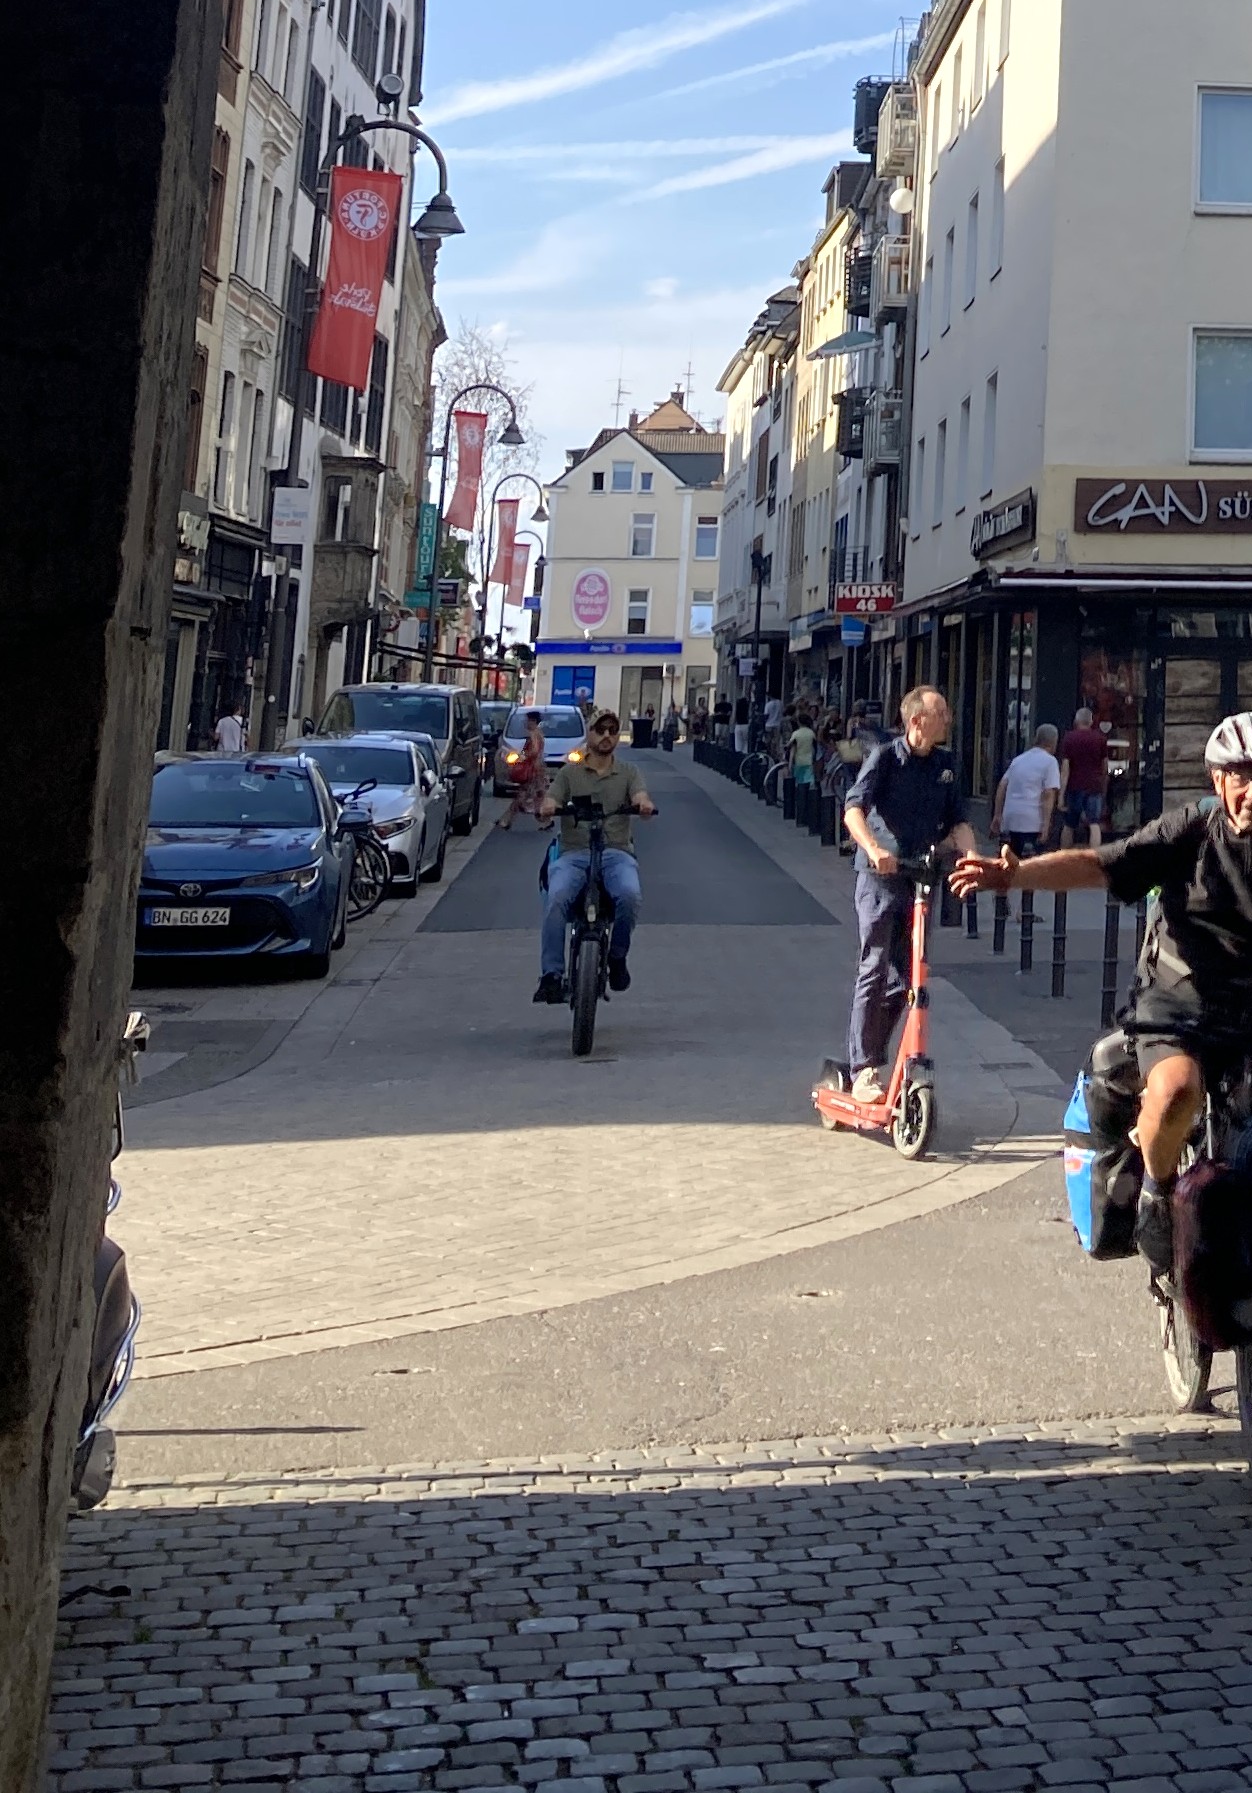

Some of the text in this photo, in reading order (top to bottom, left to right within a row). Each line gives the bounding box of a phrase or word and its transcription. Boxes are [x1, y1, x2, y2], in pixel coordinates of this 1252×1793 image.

[838, 585, 894, 598] KIOSK
[856, 599, 877, 612] 46
[153, 910, 227, 924] BN GG 624
